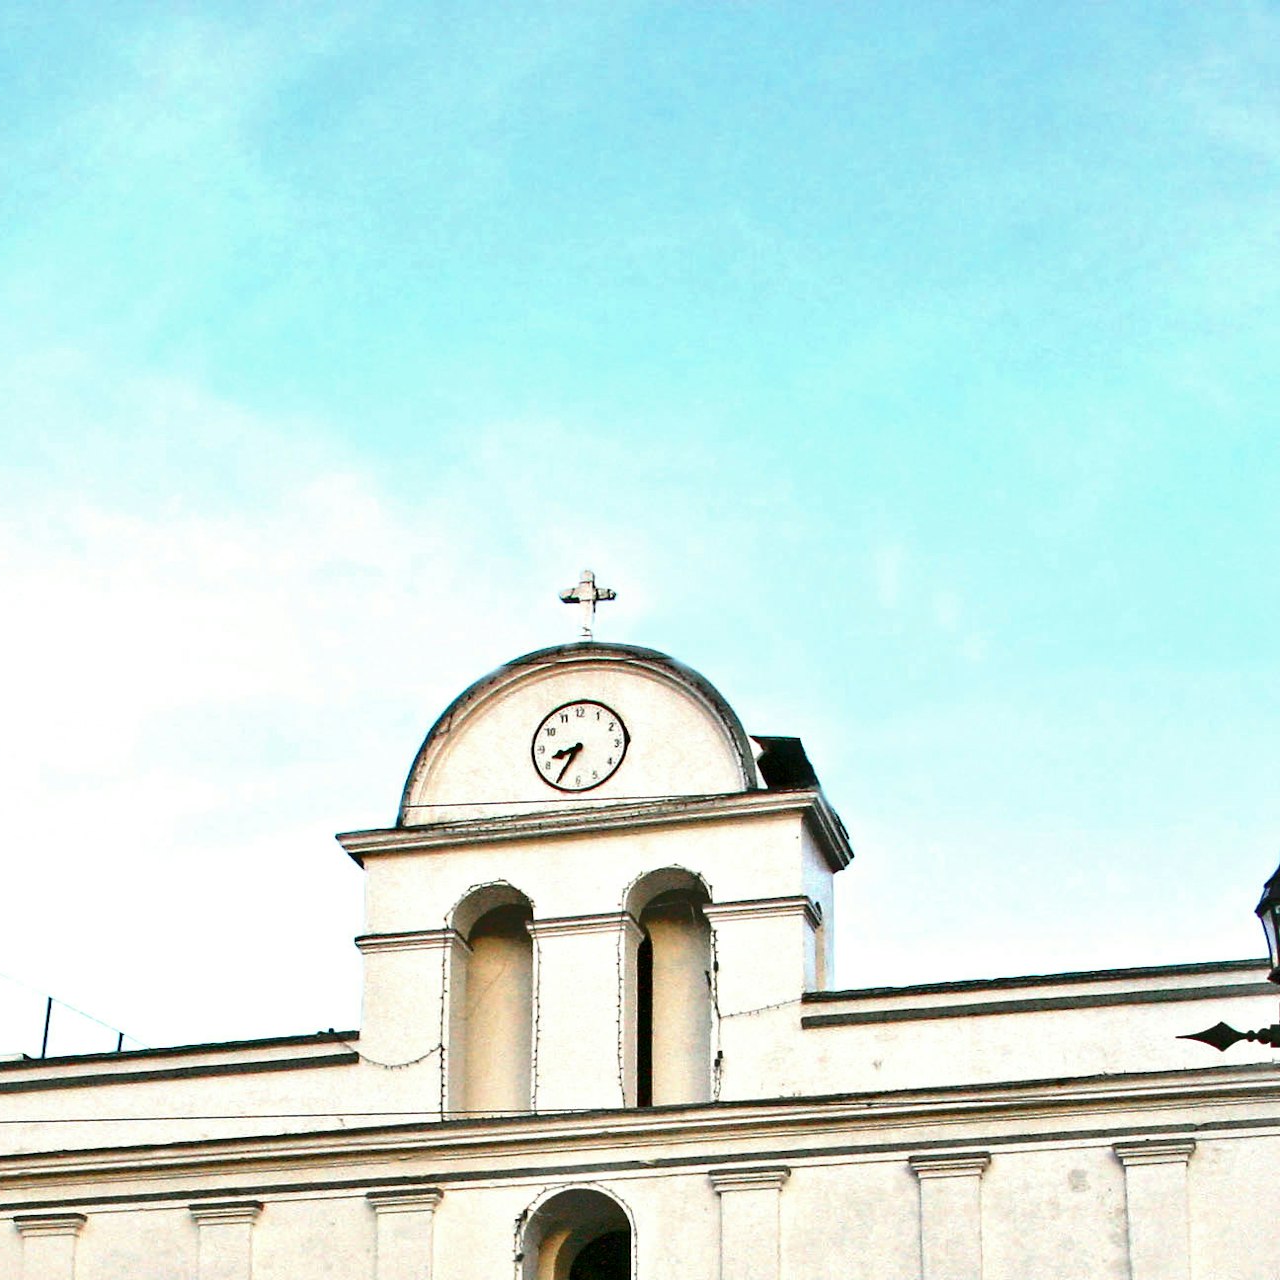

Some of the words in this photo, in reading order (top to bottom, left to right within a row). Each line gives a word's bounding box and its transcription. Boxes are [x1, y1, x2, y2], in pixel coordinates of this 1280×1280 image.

[575, 706, 585, 717] 12
[596, 711, 600, 721] 1
[560, 714, 568, 723] 11
[608, 722, 614, 731] 2
[546, 727, 556, 736] 10
[614, 739, 620, 748] 3
[539, 745, 546, 755] 9
[545, 761, 551, 770] 8
[606, 756, 613, 766] 4
[592, 770, 598, 779] 5
[575, 775, 581, 786] 6
